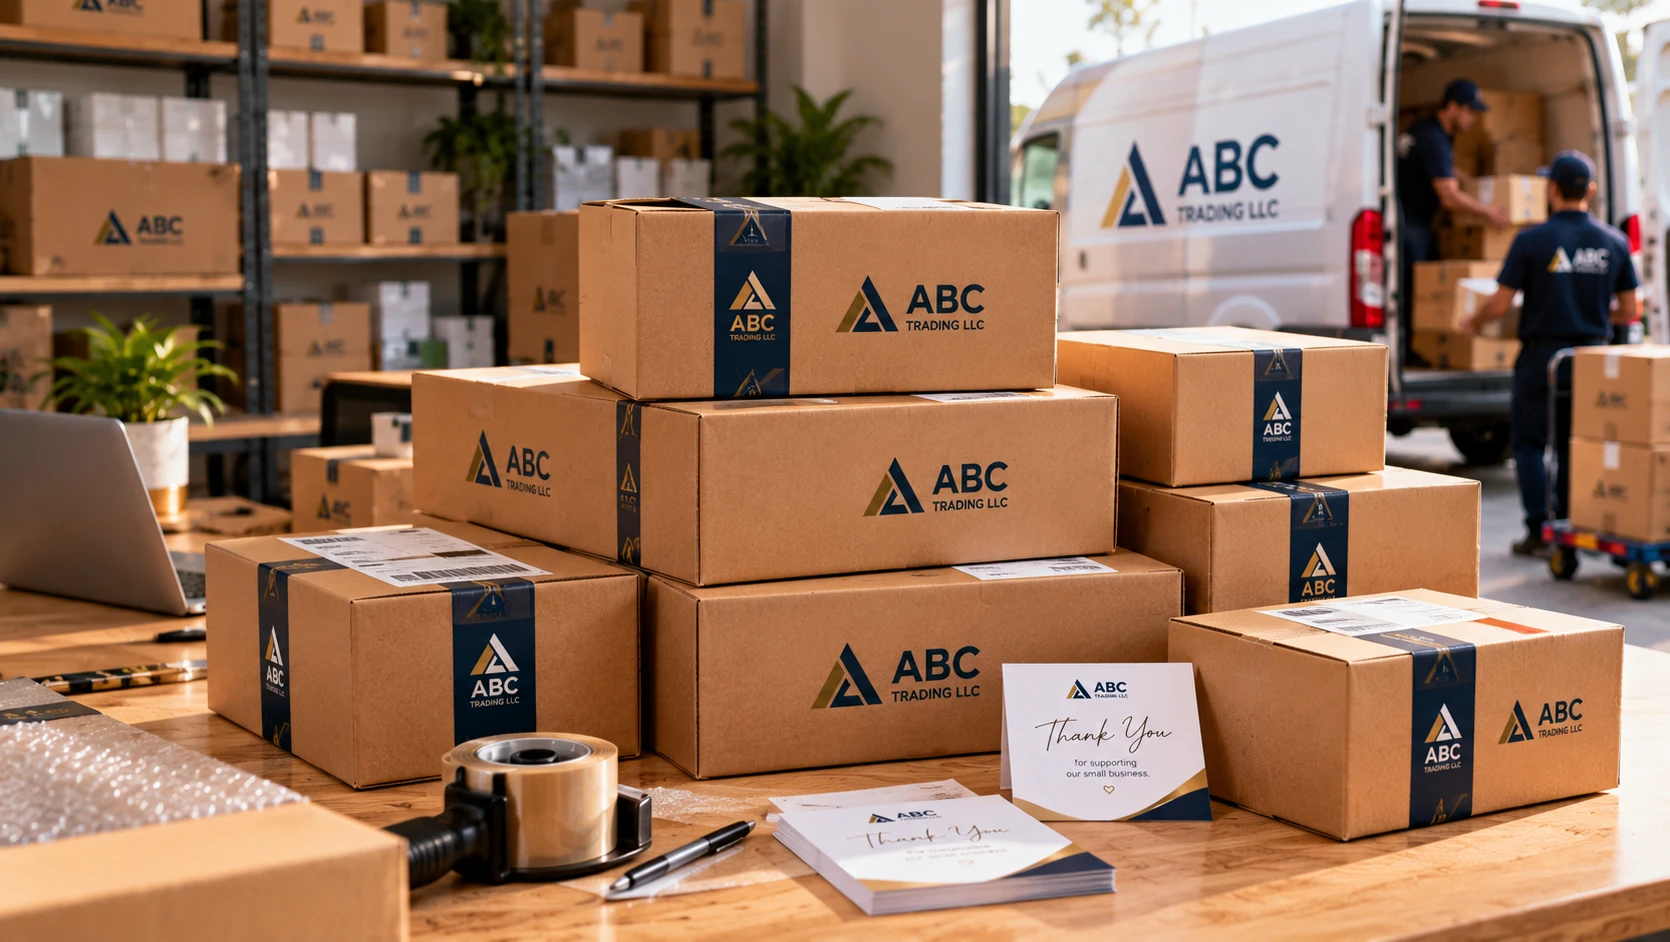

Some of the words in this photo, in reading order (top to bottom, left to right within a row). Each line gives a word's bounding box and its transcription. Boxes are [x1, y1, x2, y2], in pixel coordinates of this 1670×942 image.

[1177, 132, 1280, 198] ABC
[1176, 202, 1244, 224] TRADING
[1248, 199, 1279, 219] LLC
[137, 215, 184, 236] ABC
[906, 283, 986, 315] ABC
[729, 314, 775, 333] ABC
[906, 320, 960, 332] TRADING
[963, 319, 985, 331] LLC
[729, 334, 761, 342] TRADING
[1263, 422, 1292, 437] ABC
[506, 445, 551, 481] ABC
[932, 461, 1009, 495] ABC
[506, 479, 537, 495] TRADING
[538, 486, 551, 498] LLC
[932, 499, 985, 512] TRADING
[987, 497, 1009, 508] LLC
[1301, 579, 1335, 597] ABC
[891, 645, 981, 684] ABC
[266, 665, 284, 687] ABC
[471, 676, 519, 698] ABC
[891, 686, 952, 702] TRADING
[956, 685, 981, 698] LLC
[1094, 682, 1127, 693] ABC
[470, 698, 505, 709] TRADING
[506, 696, 520, 705] LLC
[1538, 698, 1583, 726] ABC
[1035, 717, 1115, 752] Thank
[1122, 715, 1173, 754] You
[1538, 726, 1569, 738] TRADING
[1570, 724, 1583, 733] LLC
[1424, 743, 1461, 765] ABC
[1074, 759, 1087, 767] for
[1090, 759, 1137, 769] supporting
[1083, 769, 1106, 778] small
[1109, 769, 1151, 778] business.
[897, 810, 938, 819] ABC
[846, 828, 946, 849] Thank
[948, 825, 1010, 842] You
